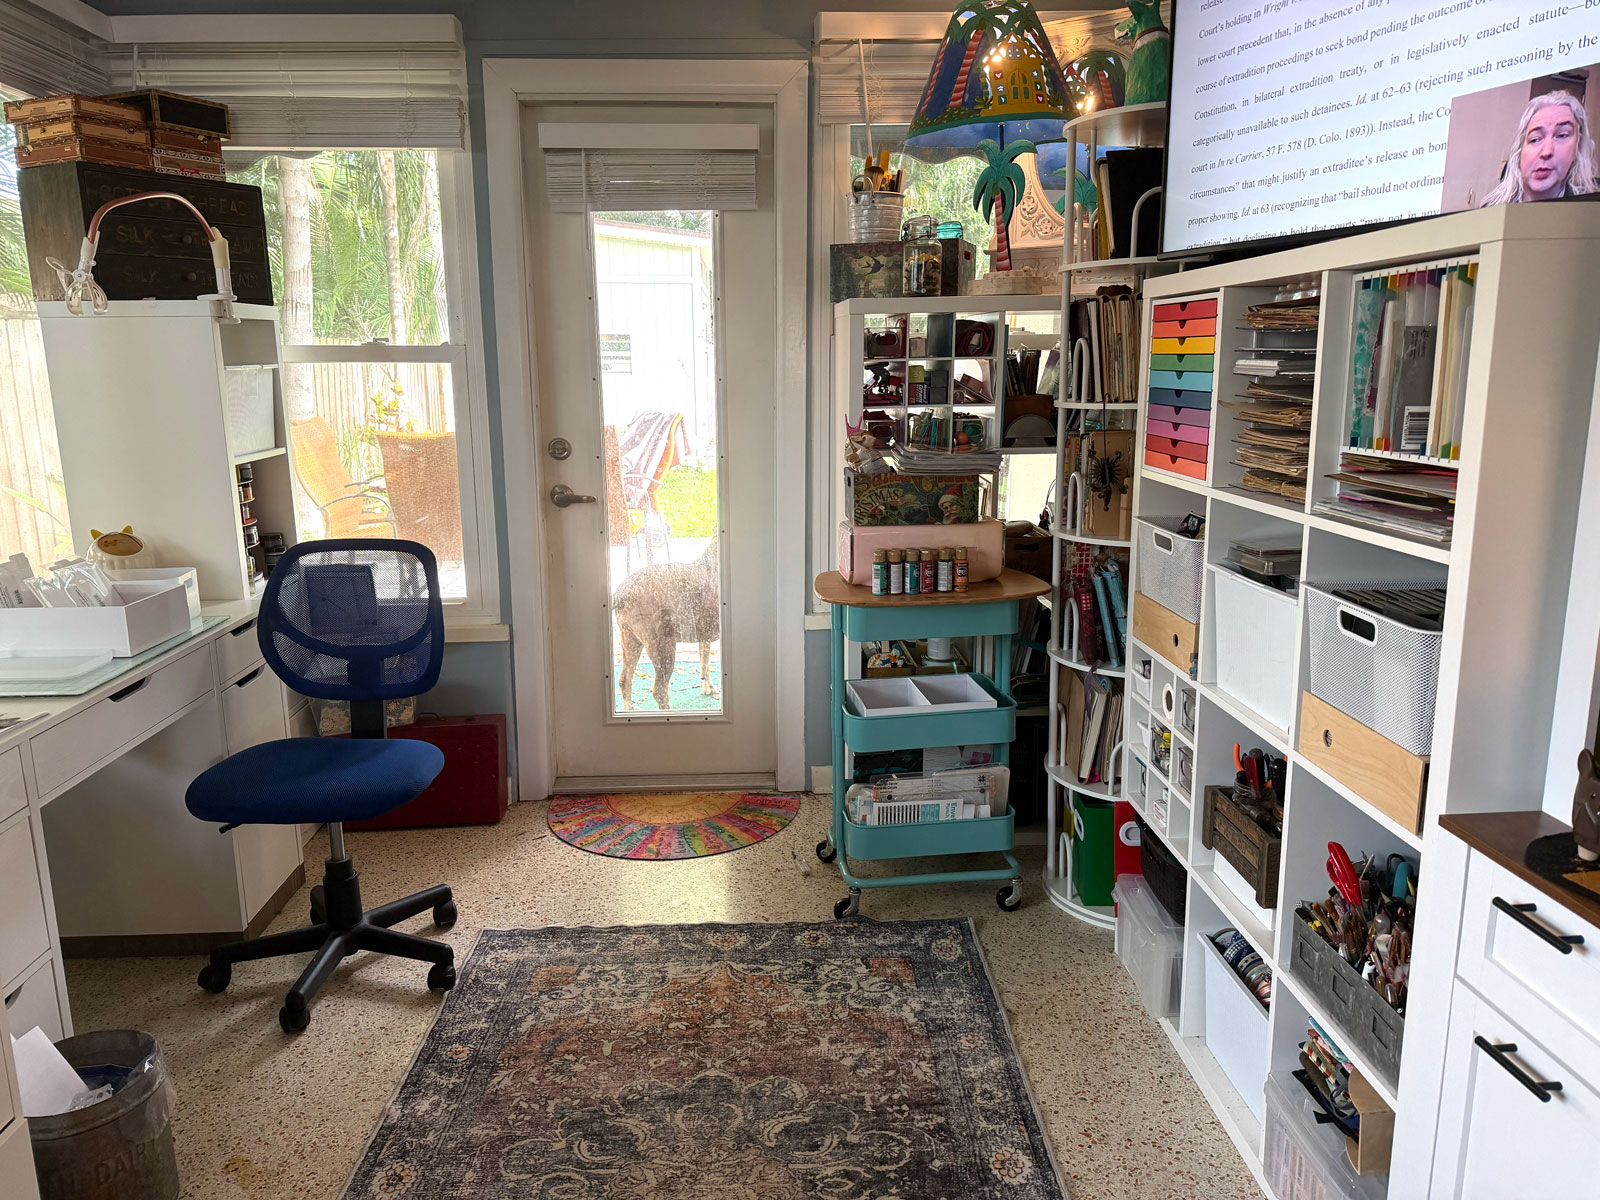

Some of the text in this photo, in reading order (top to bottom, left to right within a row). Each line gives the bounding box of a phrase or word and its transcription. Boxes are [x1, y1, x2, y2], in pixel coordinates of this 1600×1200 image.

[1197, 0, 1383, 67] lower court precedent that, in the absence of any
[1225, 13, 1252, 29] holding
[1253, 9, 1261, 19] in
[1263, 0, 1289, 15] Wright
[1194, 102, 1237, 120] Constitution,
[1242, 97, 1249, 107] in
[1254, 86, 1285, 104] bilateral
[1290, 74, 1334, 93] extradition
[1339, 65, 1367, 80] treaty,
[1373, 59, 1384, 70] or
[1390, 54, 1400, 65] in
[1407, 33, 1469, 60] legislatively
[1476, 17, 1520, 40] enacted
[1195, 81, 1217, 94] course
[1218, 75, 1227, 86] of
[1227, 65, 1266, 84] extradition
[1266, 50, 1314, 74] proceedings
[1315, 45, 1324, 56] to
[1325, 39, 1344, 53] seek
[1346, 30, 1369, 46] bond
[1370, 20, 1408, 41] pending
[1410, 12, 1425, 26] the
[1427, 0, 1473, 20] outcome
[1192, 129, 1235, 147] categorically
[1236, 117, 1278, 136] unavailable
[1280, 116, 1289, 125] to
[1290, 109, 1309, 122] such
[1311, 100, 1353, 116] detainees.
[1355, 93, 1367, 106] Id.
[1370, 91, 1380, 102] at
[1414, 70, 1464, 93] (rejecting
[1467, 61, 1492, 77] such
[1496, 47, 1553, 70] reasoning
[1558, 41, 1574, 56] by
[1578, 35, 1599, 49] the
[1191, 106, 1451, 174] court in In re Carrier, 57 F. 578 (D. Colo. 1893)). Instead, the Co
[1189, 142, 1447, 200] circumstances” that might justify an extraditee’s release on bon
[1188, 215, 1209, 228] proper
[1209, 210, 1240, 222] showing.
[1241, 206, 1250, 217] Id.
[1252, 206, 1259, 215] at
[1260, 203, 1270, 214] 63
[1271, 196, 1320, 214] (recognizing
[1321, 193, 1337, 204] that
[1338, 188, 1360, 200] “bail
[1361, 182, 1391, 197] should
[1393, 180, 1408, 192] not
[1311, 224, 1327, 232] that
[1330, 220, 1356, 230] courts
[1388, 213, 1403, 222] not
[1408, 210, 1417, 219] in
[115, 224, 153, 245] SILK
[853, 488, 905, 526] HRISTMAS
